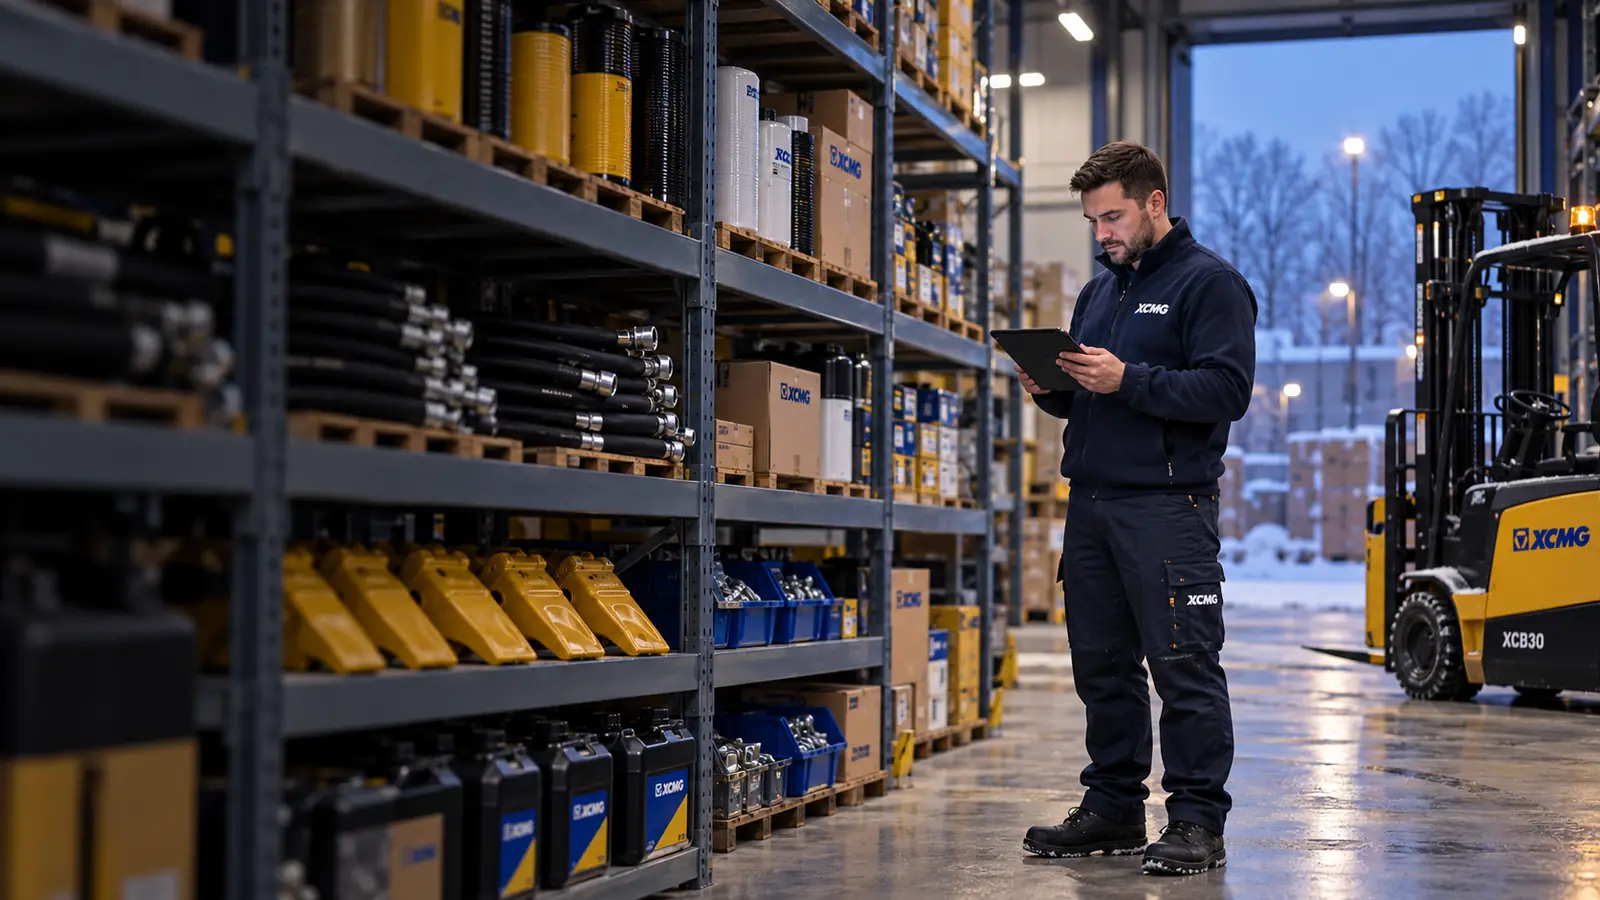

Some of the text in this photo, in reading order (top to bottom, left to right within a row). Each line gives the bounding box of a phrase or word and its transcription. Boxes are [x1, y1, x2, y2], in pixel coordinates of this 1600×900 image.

[837, 151, 861, 179] XCMG
[1134, 303, 1169, 315] XCMG
[788, 386, 810, 405] XCMG
[1530, 525, 1591, 550] XCMG
[1186, 593, 1218, 606] XCMG
[1502, 631, 1544, 650] XCB30
[662, 779, 684, 796] XCMG
